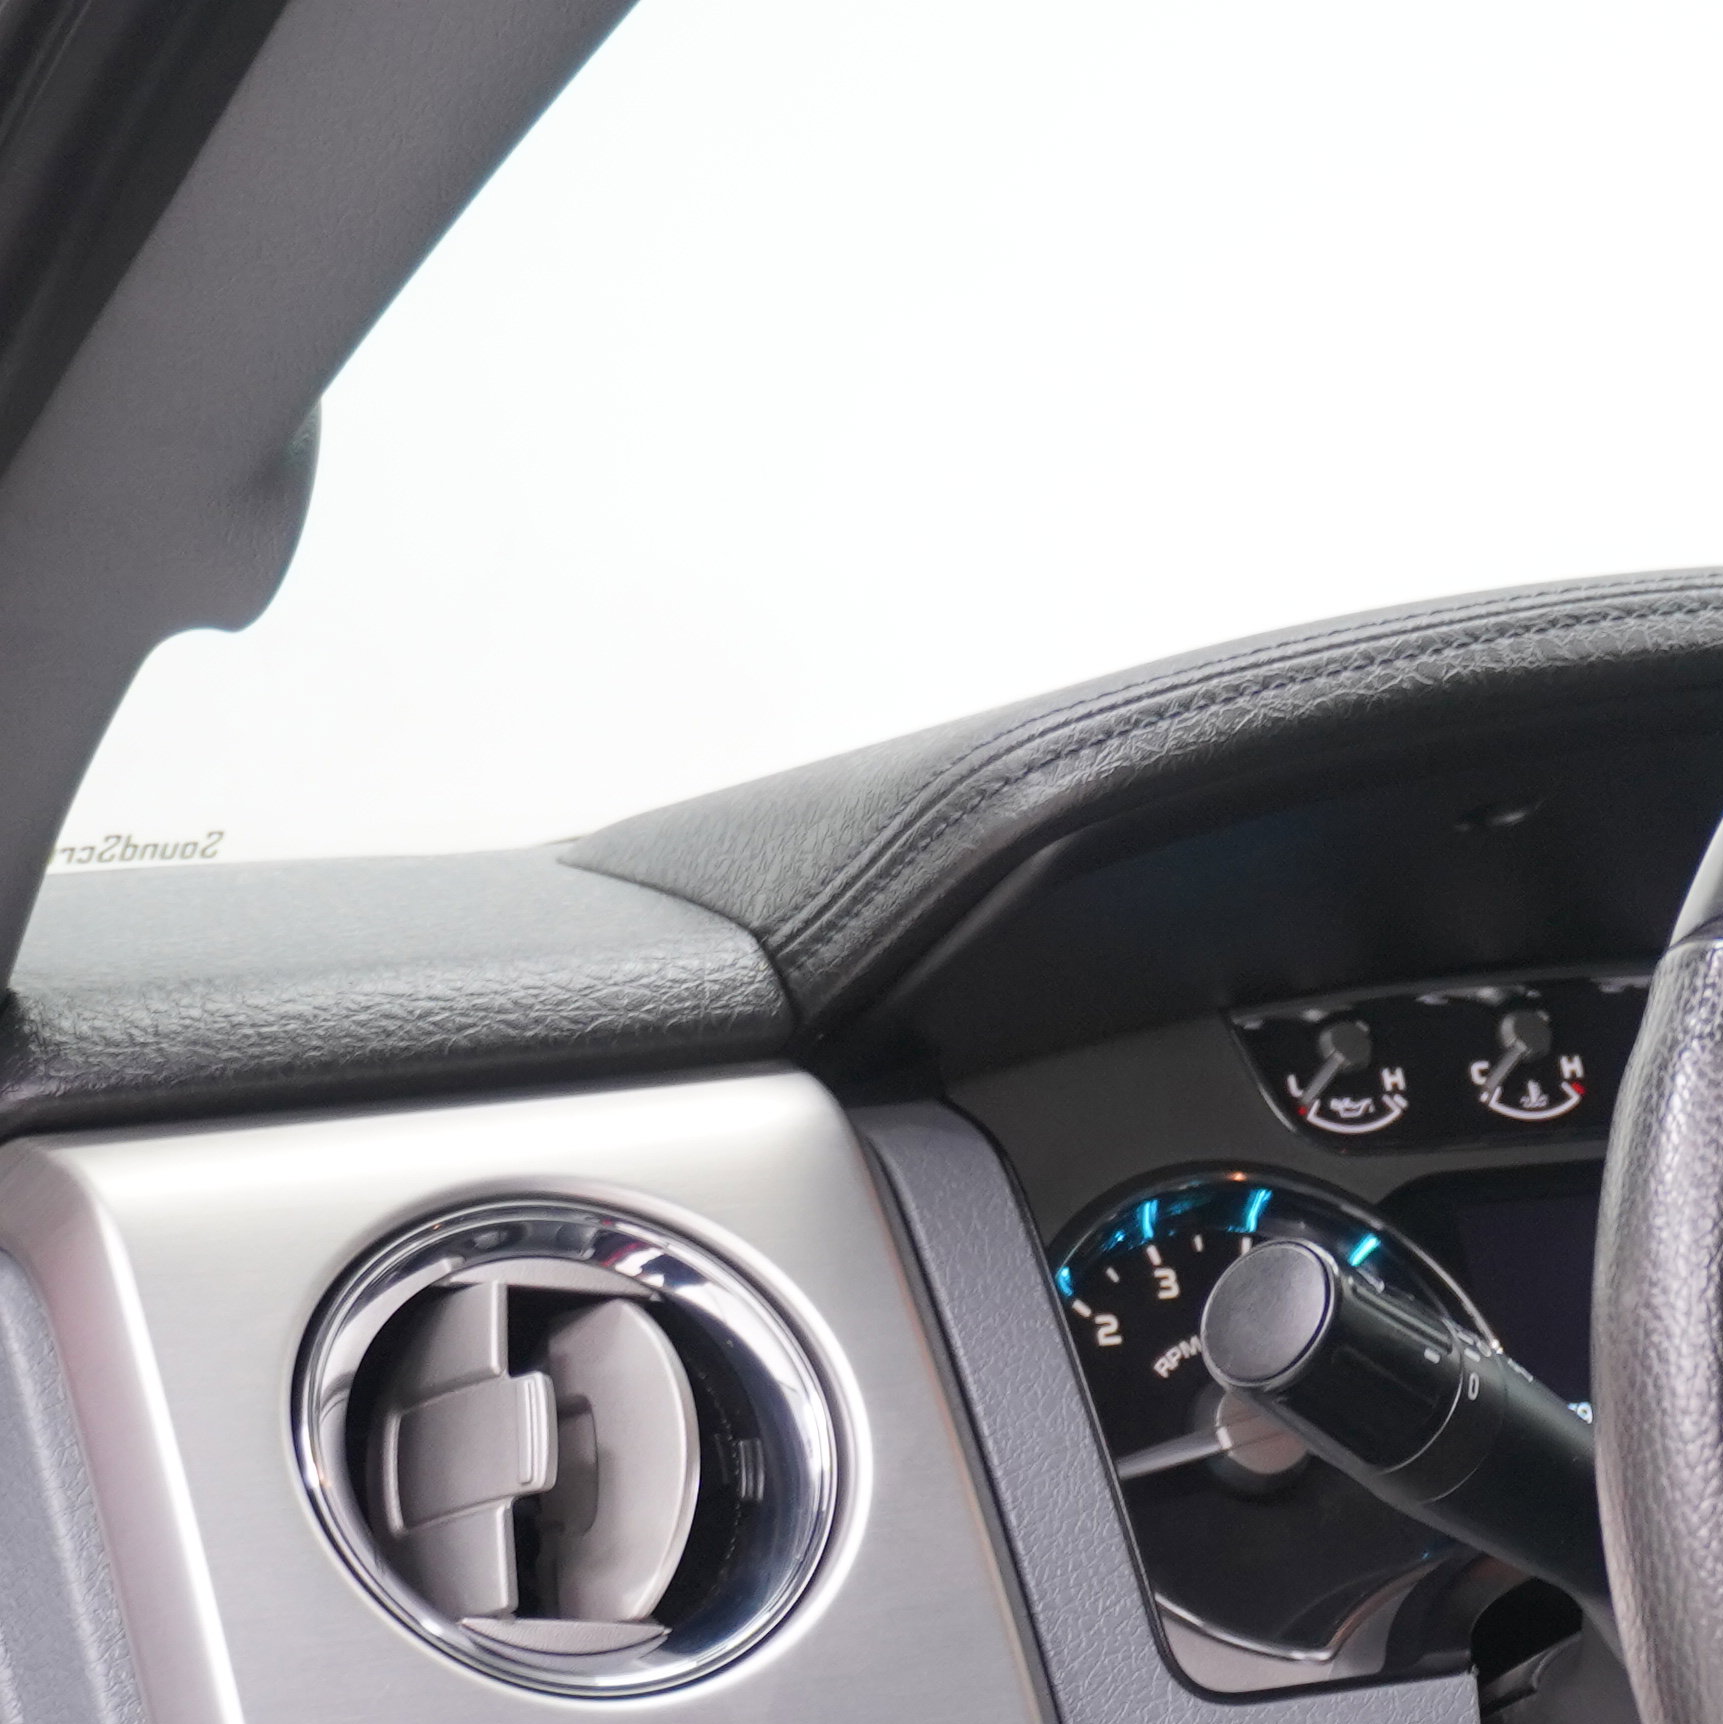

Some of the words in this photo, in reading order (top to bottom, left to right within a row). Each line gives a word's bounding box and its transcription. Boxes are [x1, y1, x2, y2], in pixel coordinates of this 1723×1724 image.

[1380, 1066, 1406, 1092] H
[1470, 1060, 1491, 1085] C
[1560, 1054, 1585, 1079] H
[1153, 1266, 1180, 1299] 3
[1094, 1313, 1123, 1346] 2
[1153, 1334, 1201, 1378] RPM
